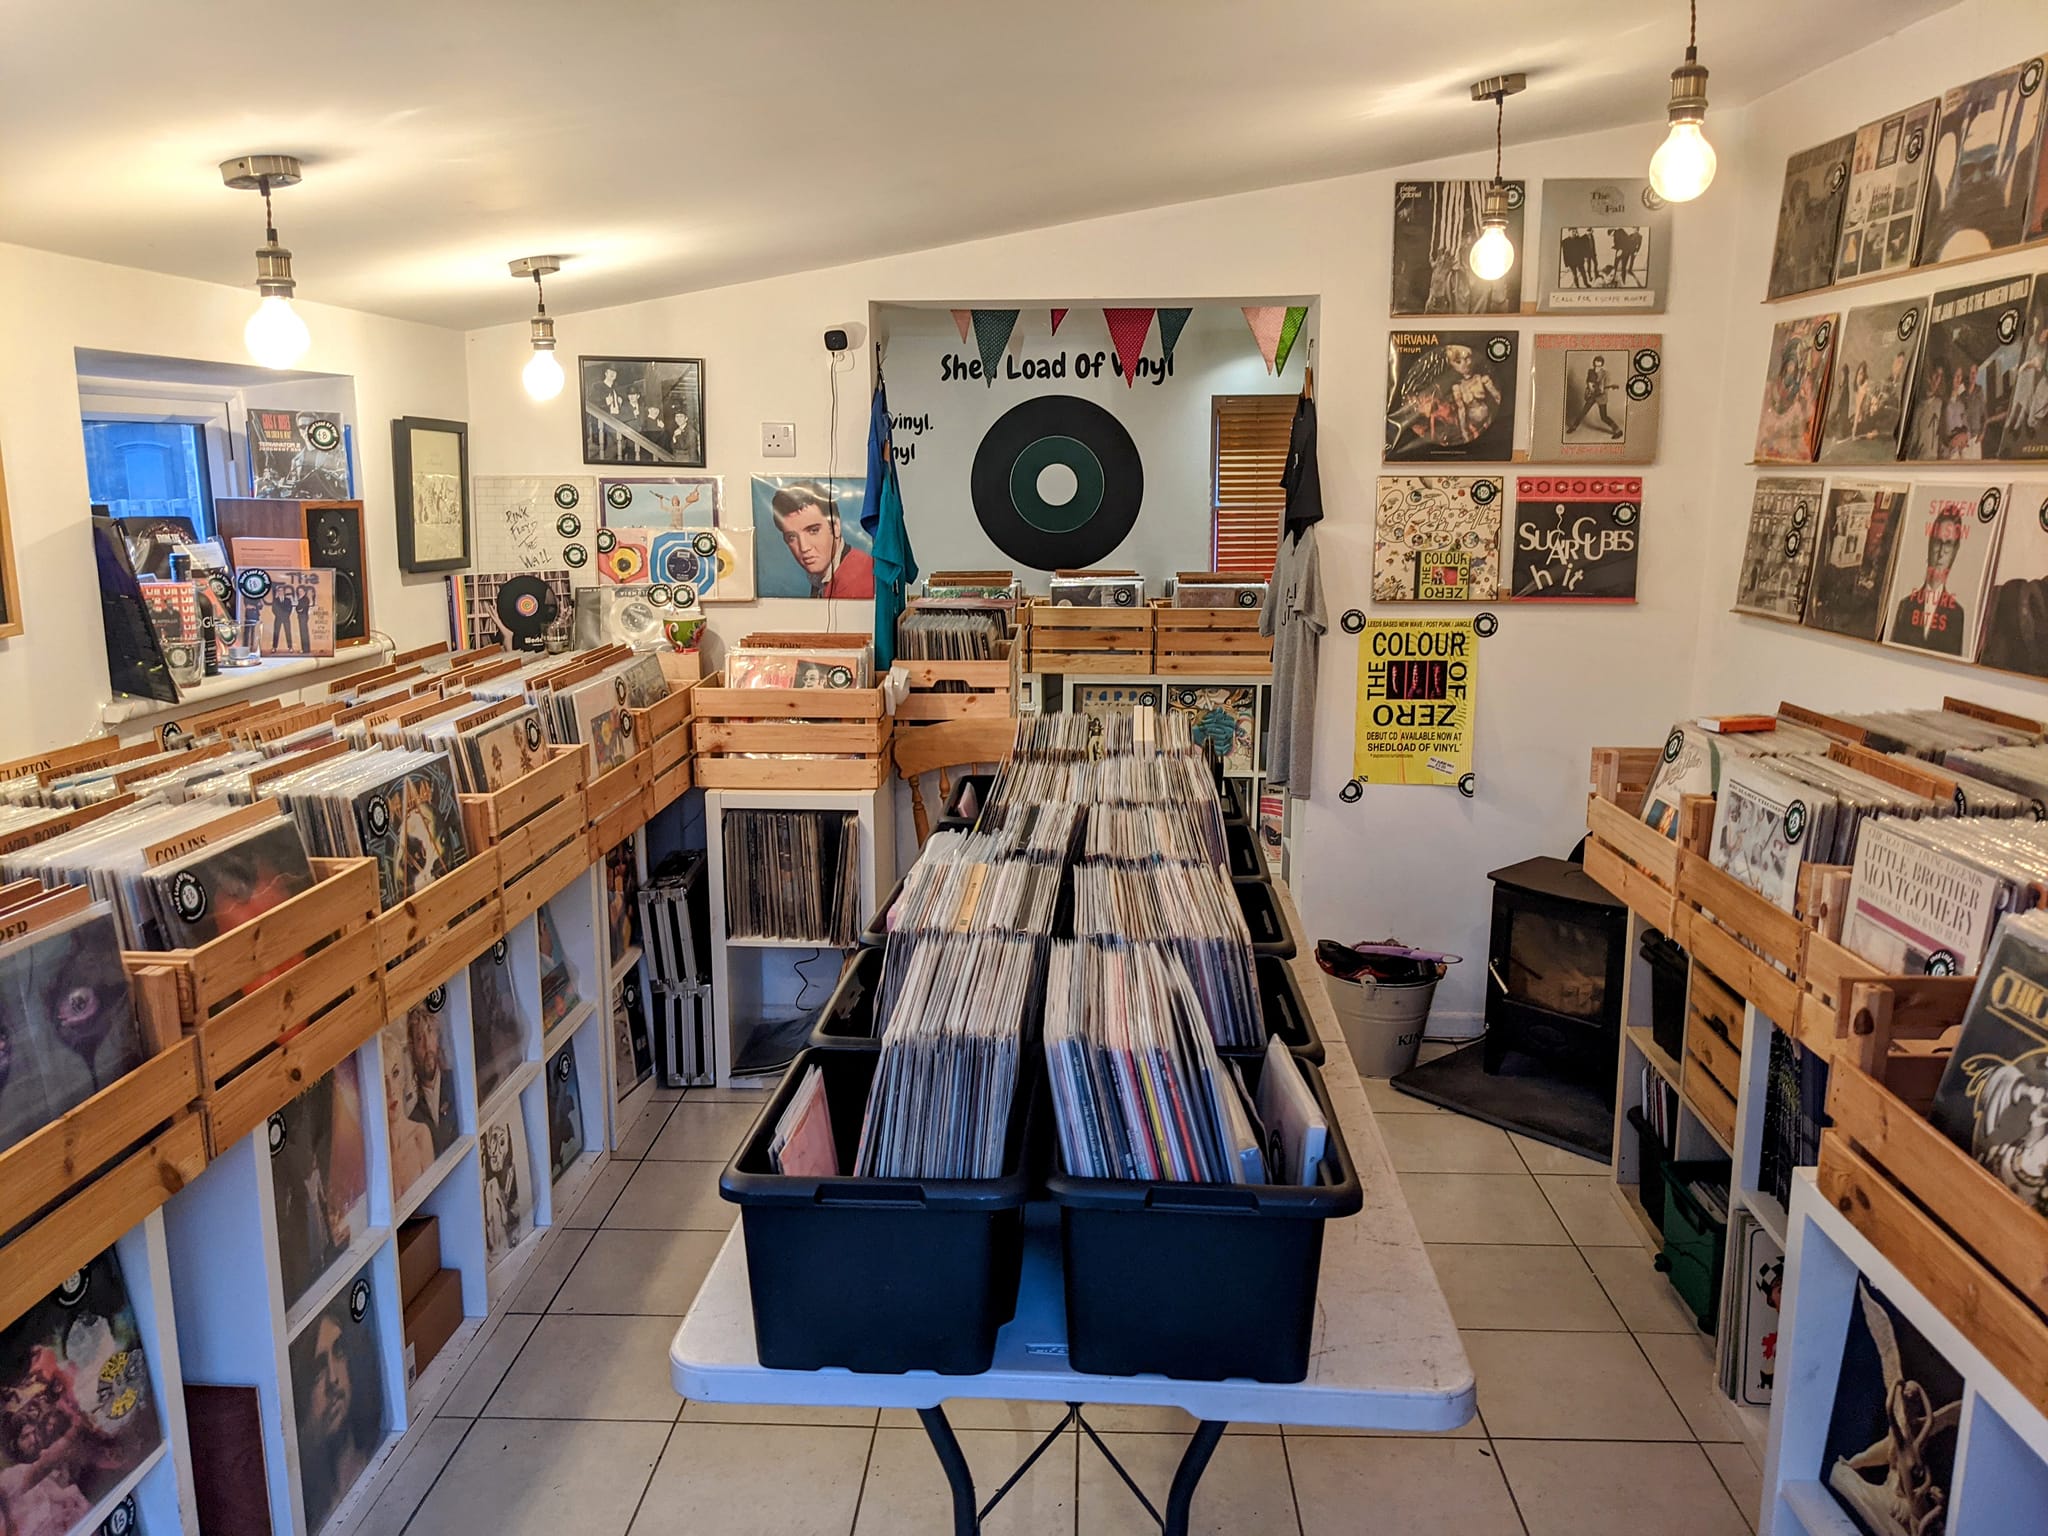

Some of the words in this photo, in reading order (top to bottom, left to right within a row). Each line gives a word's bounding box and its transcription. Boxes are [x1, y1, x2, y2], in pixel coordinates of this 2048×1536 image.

[1591, 191, 1610, 200] The
[1392, 334, 1439, 345] NIRVANA
[941, 354, 997, 381] She
[1007, 351, 1066, 379] Load
[1075, 352, 1105, 378] Of
[1112, 352, 1174, 386] Vnyl
[1929, 500, 1977, 516] STEVEN
[1925, 525, 1970, 540] WILSON
[1424, 552, 1467, 565] COLOUR
[1422, 566, 1430, 585] THE
[1459, 567, 1468, 585] OF
[1424, 587, 1464, 598] ZERO
[1910, 588, 1957, 609] FUTURE
[1911, 611, 1947, 631] BITES
[1373, 632, 1466, 657] COLOUR
[1367, 661, 1386, 700] THE
[1449, 662, 1467, 700] OF
[1373, 704, 1456, 727] ZERO
[1367, 732, 1388, 741] DEBUT
[1389, 732, 1398, 741] CD
[1400, 732, 1435, 741] AVAILABLE
[1437, 732, 1452, 741] NOW
[1454, 732, 1462, 741] AT
[1367, 743, 1416, 752] SHEDLOAD
[1419, 743, 1431, 752] OF
[1, 834, 29, 853] AVID
[156, 834, 208, 864] COLLINS
[1865, 840, 1907, 876] LITTLE
[1912, 862, 1980, 910] BROTHER
[1863, 860, 1971, 936] MONTGOMERY
